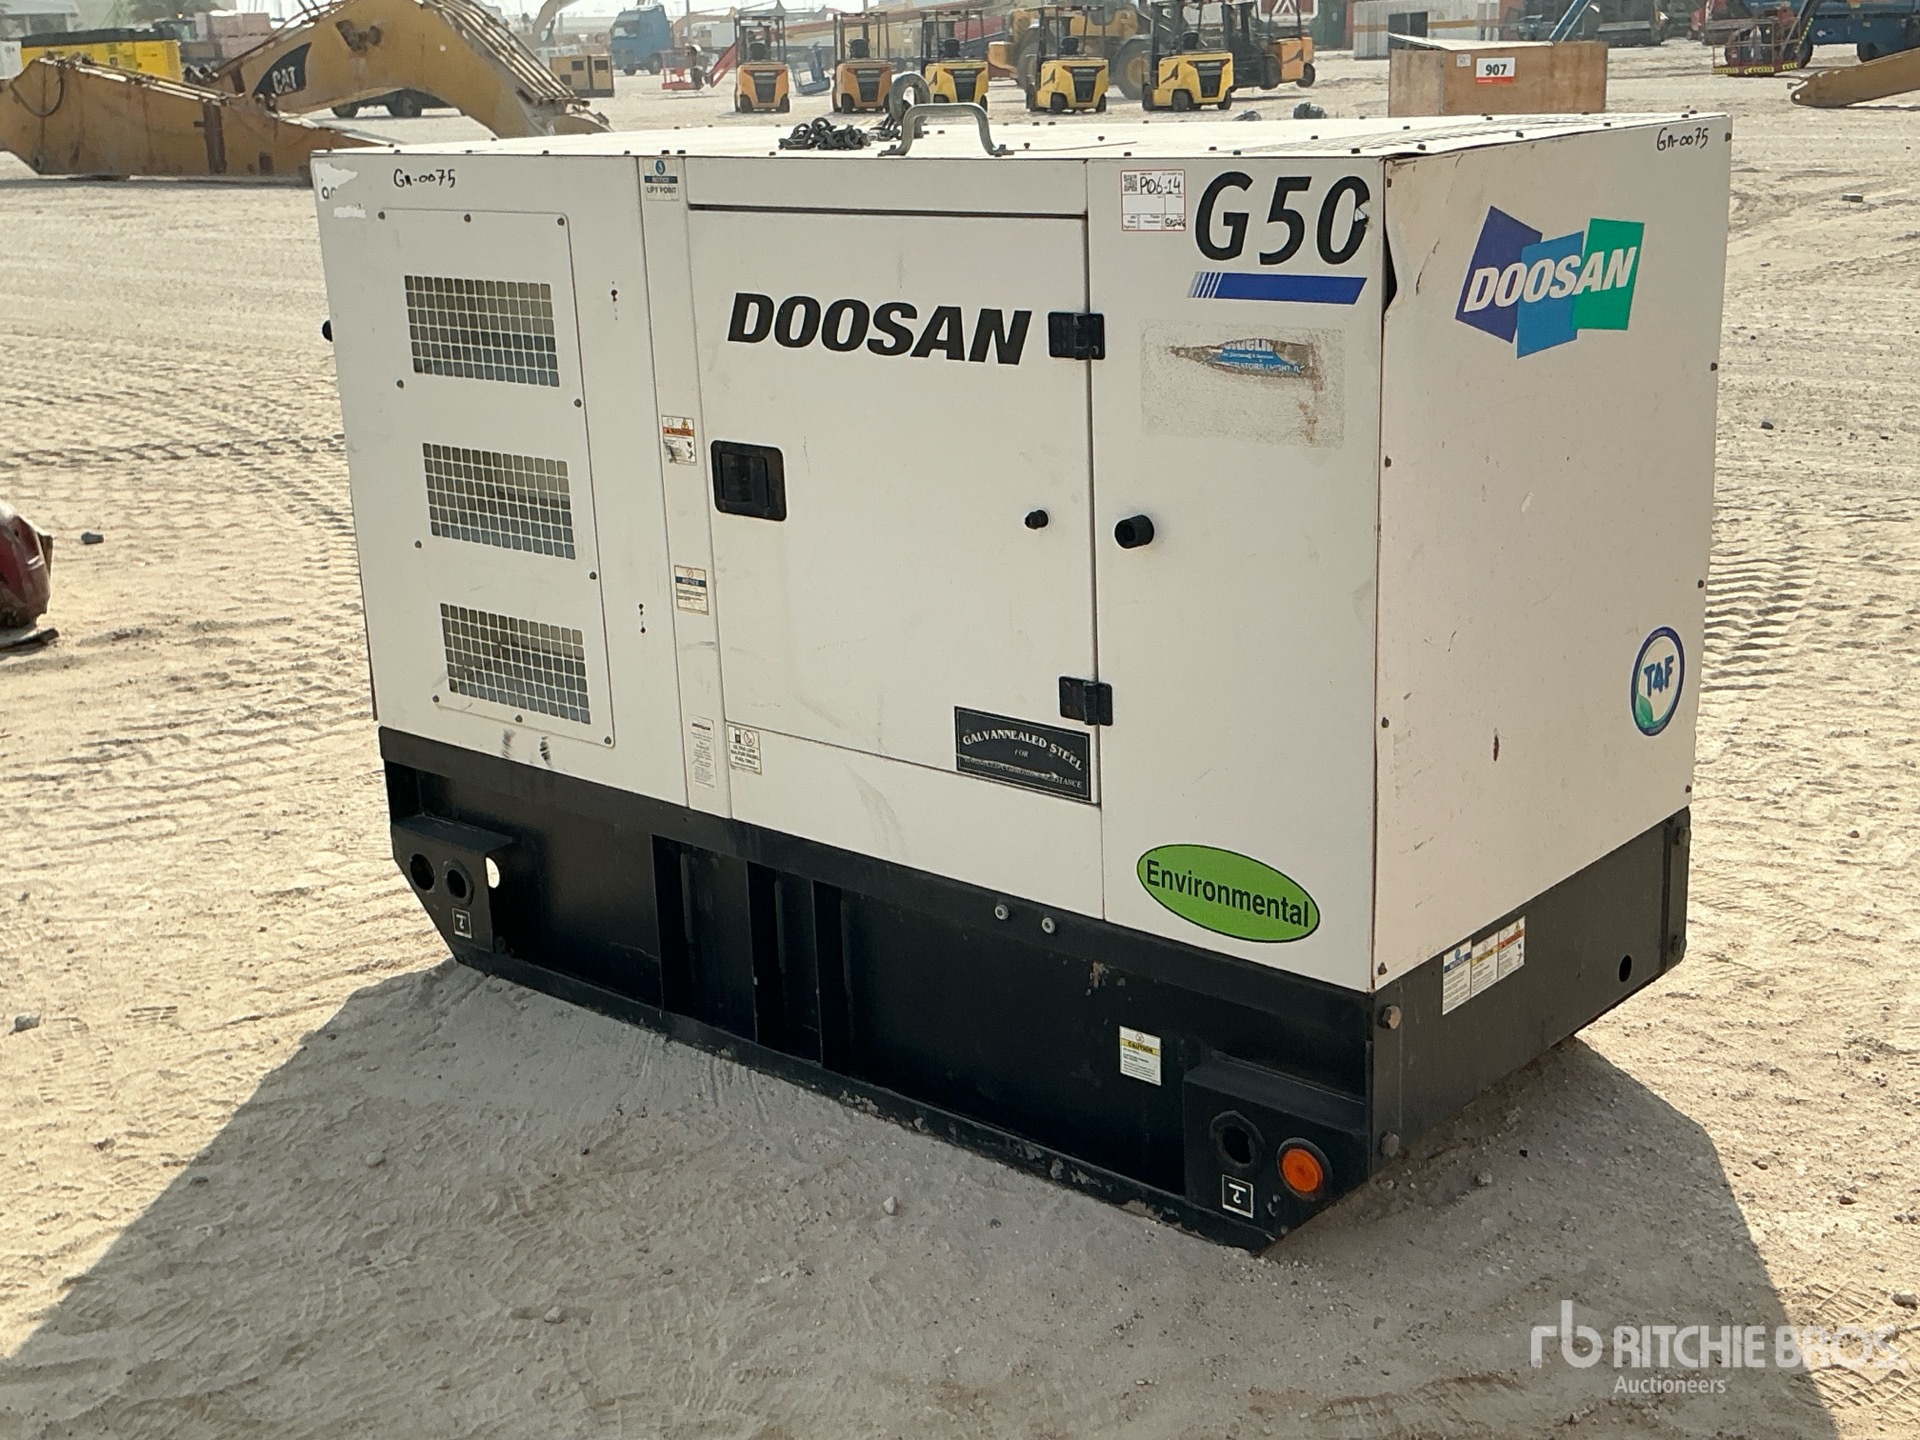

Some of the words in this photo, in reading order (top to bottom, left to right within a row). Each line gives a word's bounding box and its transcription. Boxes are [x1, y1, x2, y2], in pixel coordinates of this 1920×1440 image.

[272, 66, 297, 94] CAT
[1485, 64, 1507, 76] 907
[1195, 171, 1371, 266] G50
[1463, 246, 1637, 313] DOOSAN
[727, 292, 1032, 365] DOOSAN
[963, 730, 1047, 748] GALVANNEALED
[1049, 743, 1082, 771] STEEL
[1015, 749, 1029, 758] FOR
[1147, 859, 1309, 927] Environmental
[1128, 1041, 1154, 1054] CAUTION
